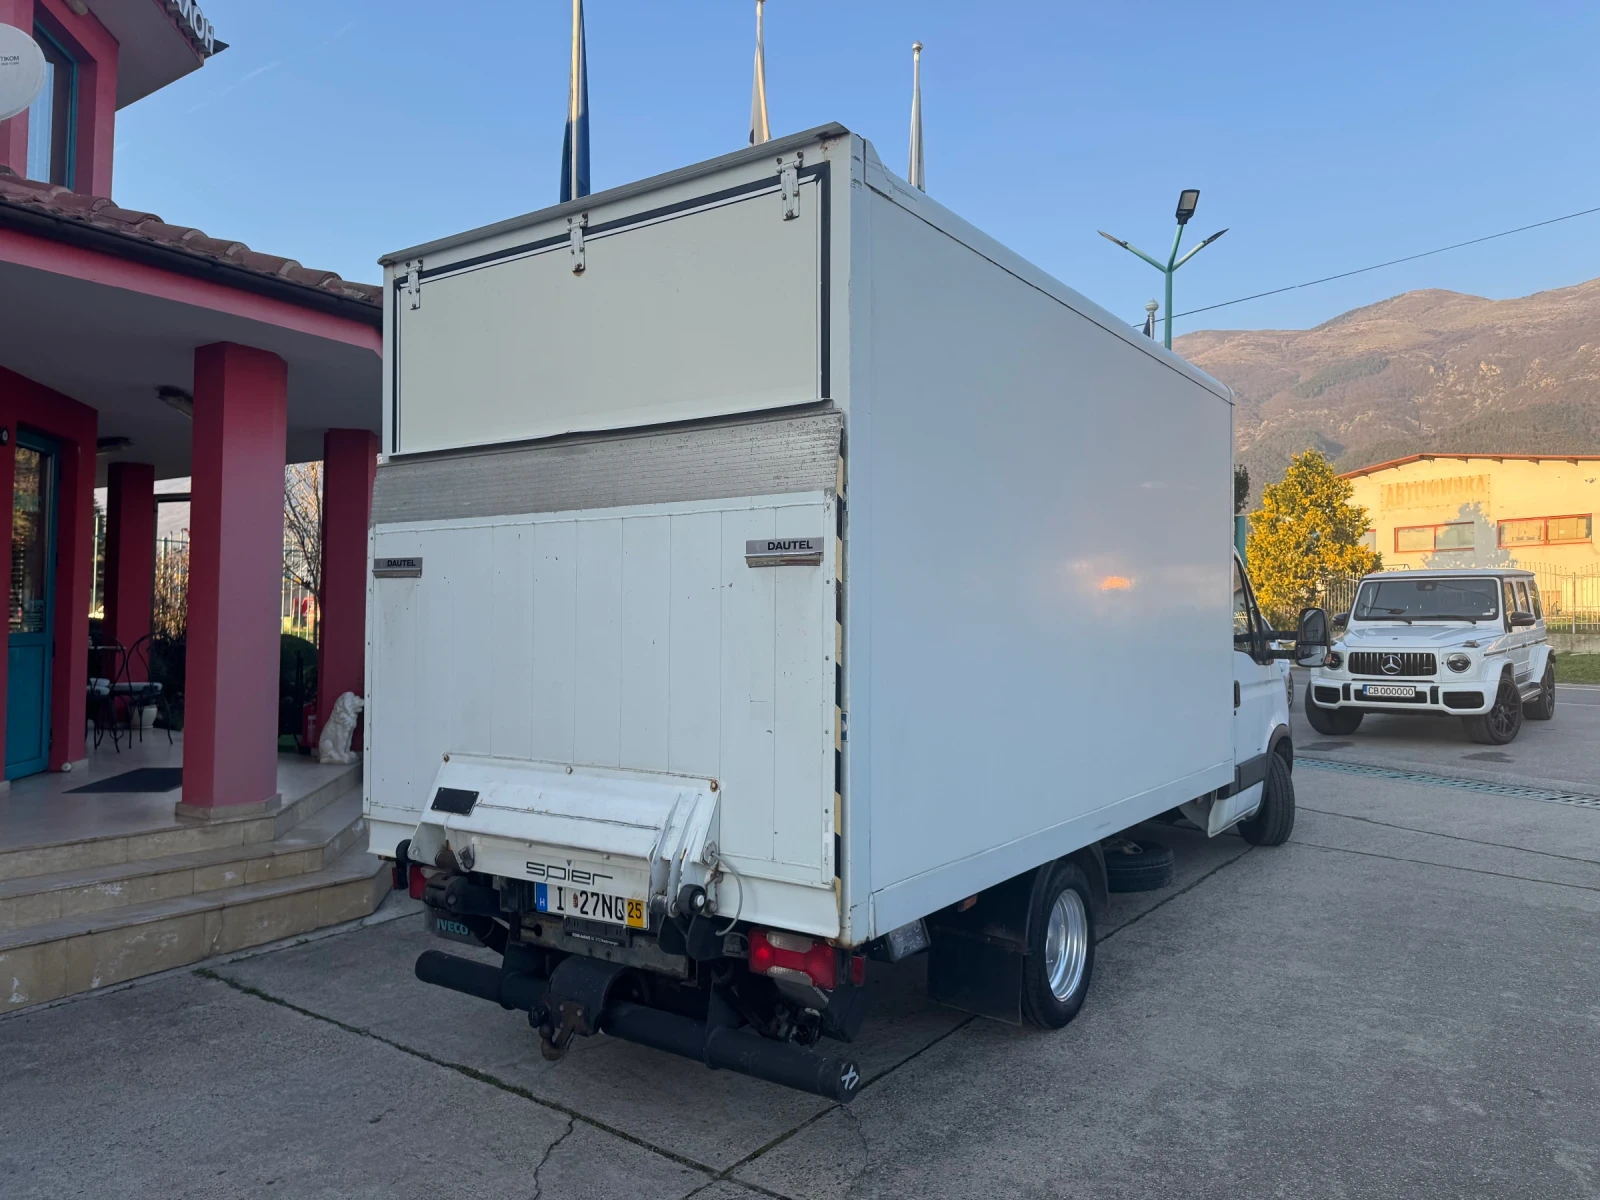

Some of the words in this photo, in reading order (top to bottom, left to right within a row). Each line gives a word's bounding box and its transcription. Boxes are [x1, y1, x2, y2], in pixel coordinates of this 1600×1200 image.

[768, 540, 813, 550] DAUTEL
[387, 559, 416, 567] DAUTEL
[1368, 687, 1379, 695] CB
[1380, 687, 1413, 695] 000000
[525, 860, 614, 885] spier
[627, 901, 643, 920] 25
[436, 918, 469, 936] IVECO
